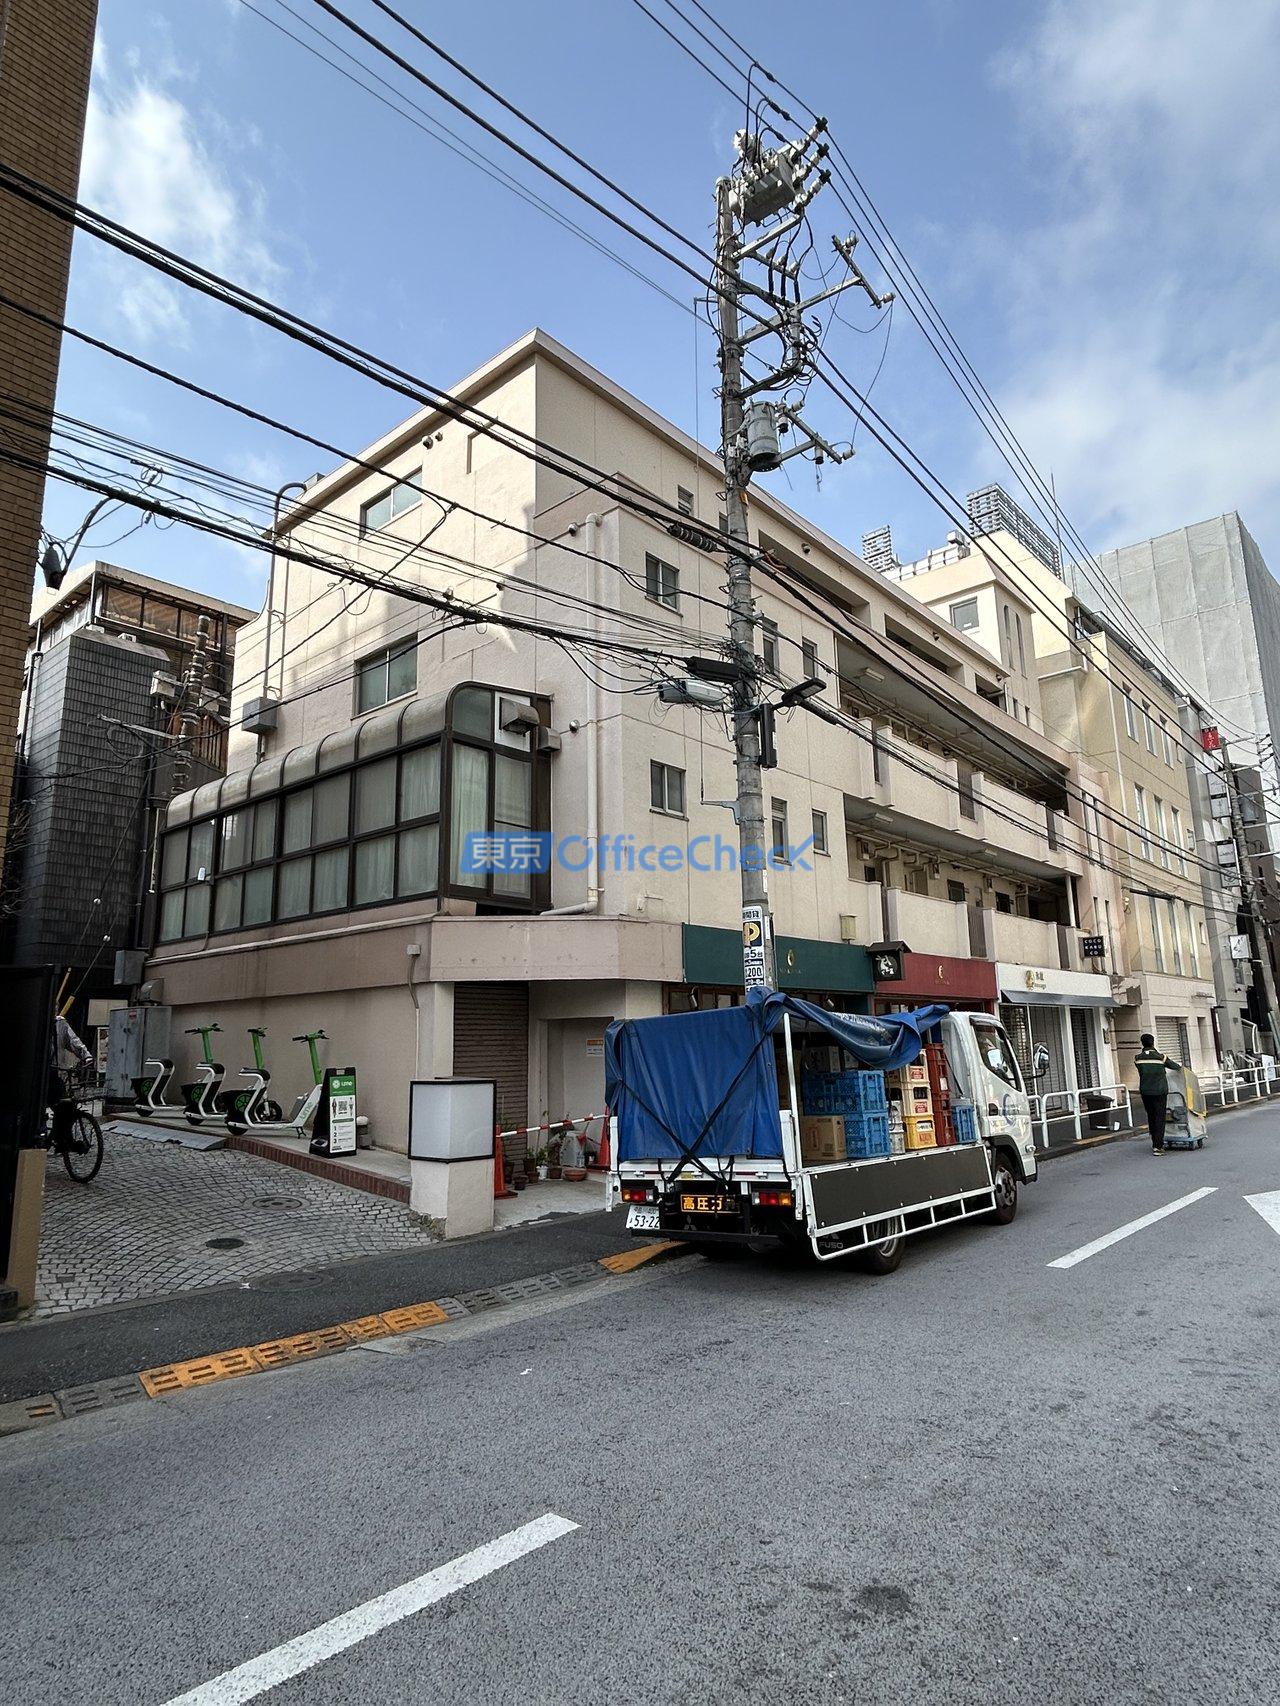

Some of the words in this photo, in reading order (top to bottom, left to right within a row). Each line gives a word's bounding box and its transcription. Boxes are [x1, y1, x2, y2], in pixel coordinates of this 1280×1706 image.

[683, 1197, 736, 1210] 高圧ガ
[818, 1241, 844, 1249] FUSO
